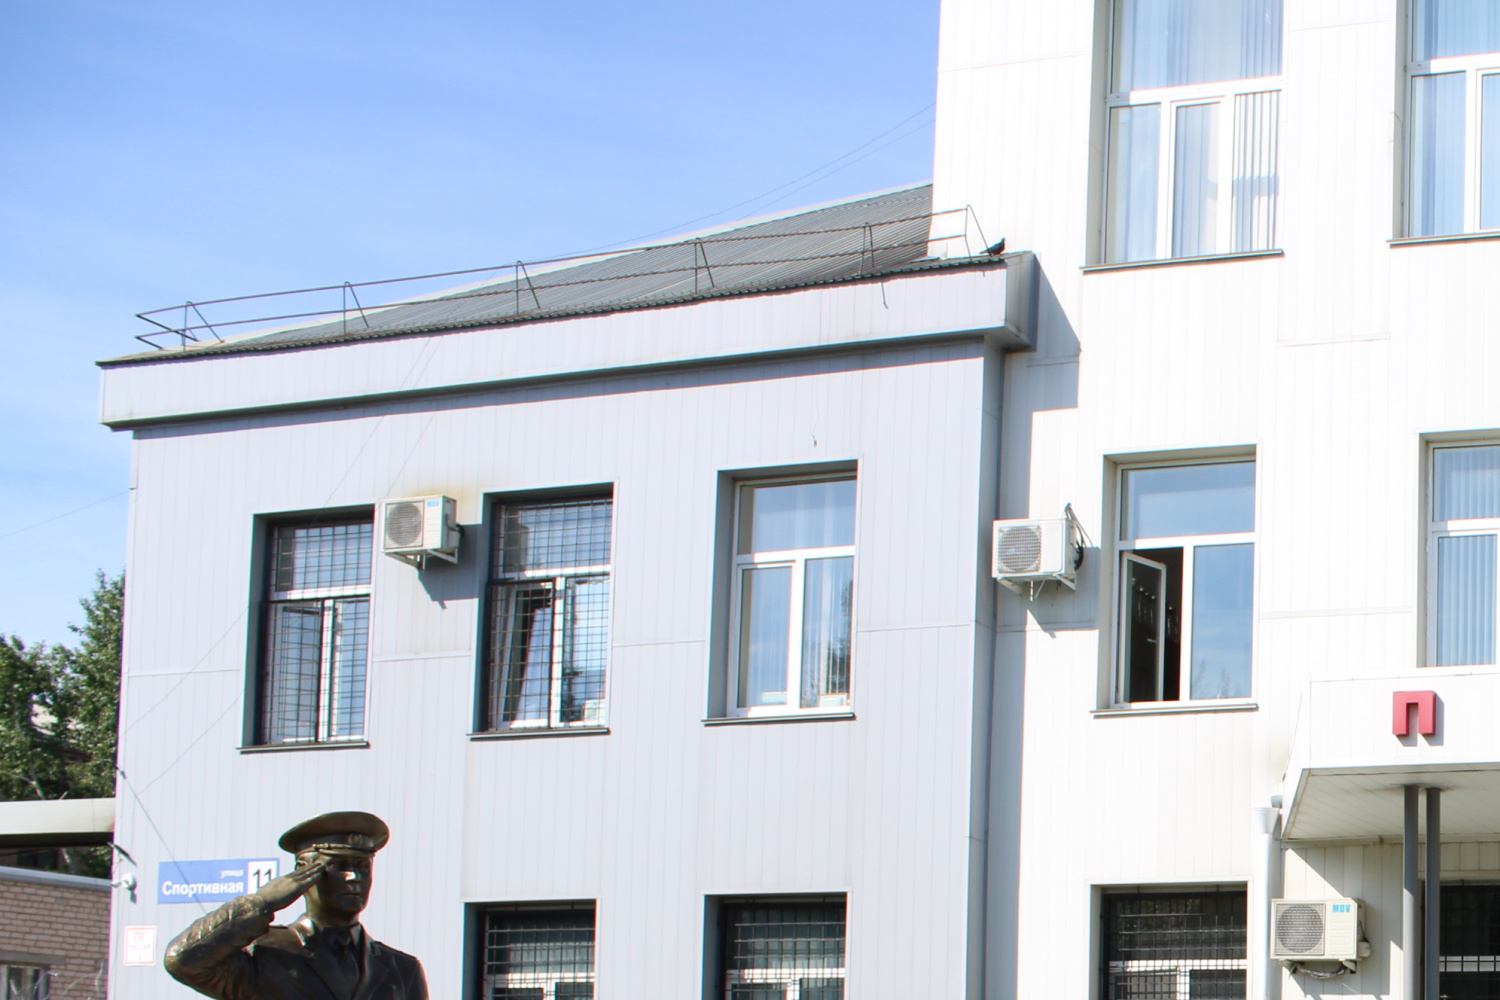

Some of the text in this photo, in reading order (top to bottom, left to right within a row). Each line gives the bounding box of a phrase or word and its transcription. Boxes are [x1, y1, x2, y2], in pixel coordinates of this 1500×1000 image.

[221, 869, 244, 879] улица
[162, 880, 244, 898] Спортивная
[1332, 904, 1351, 913] MDV
